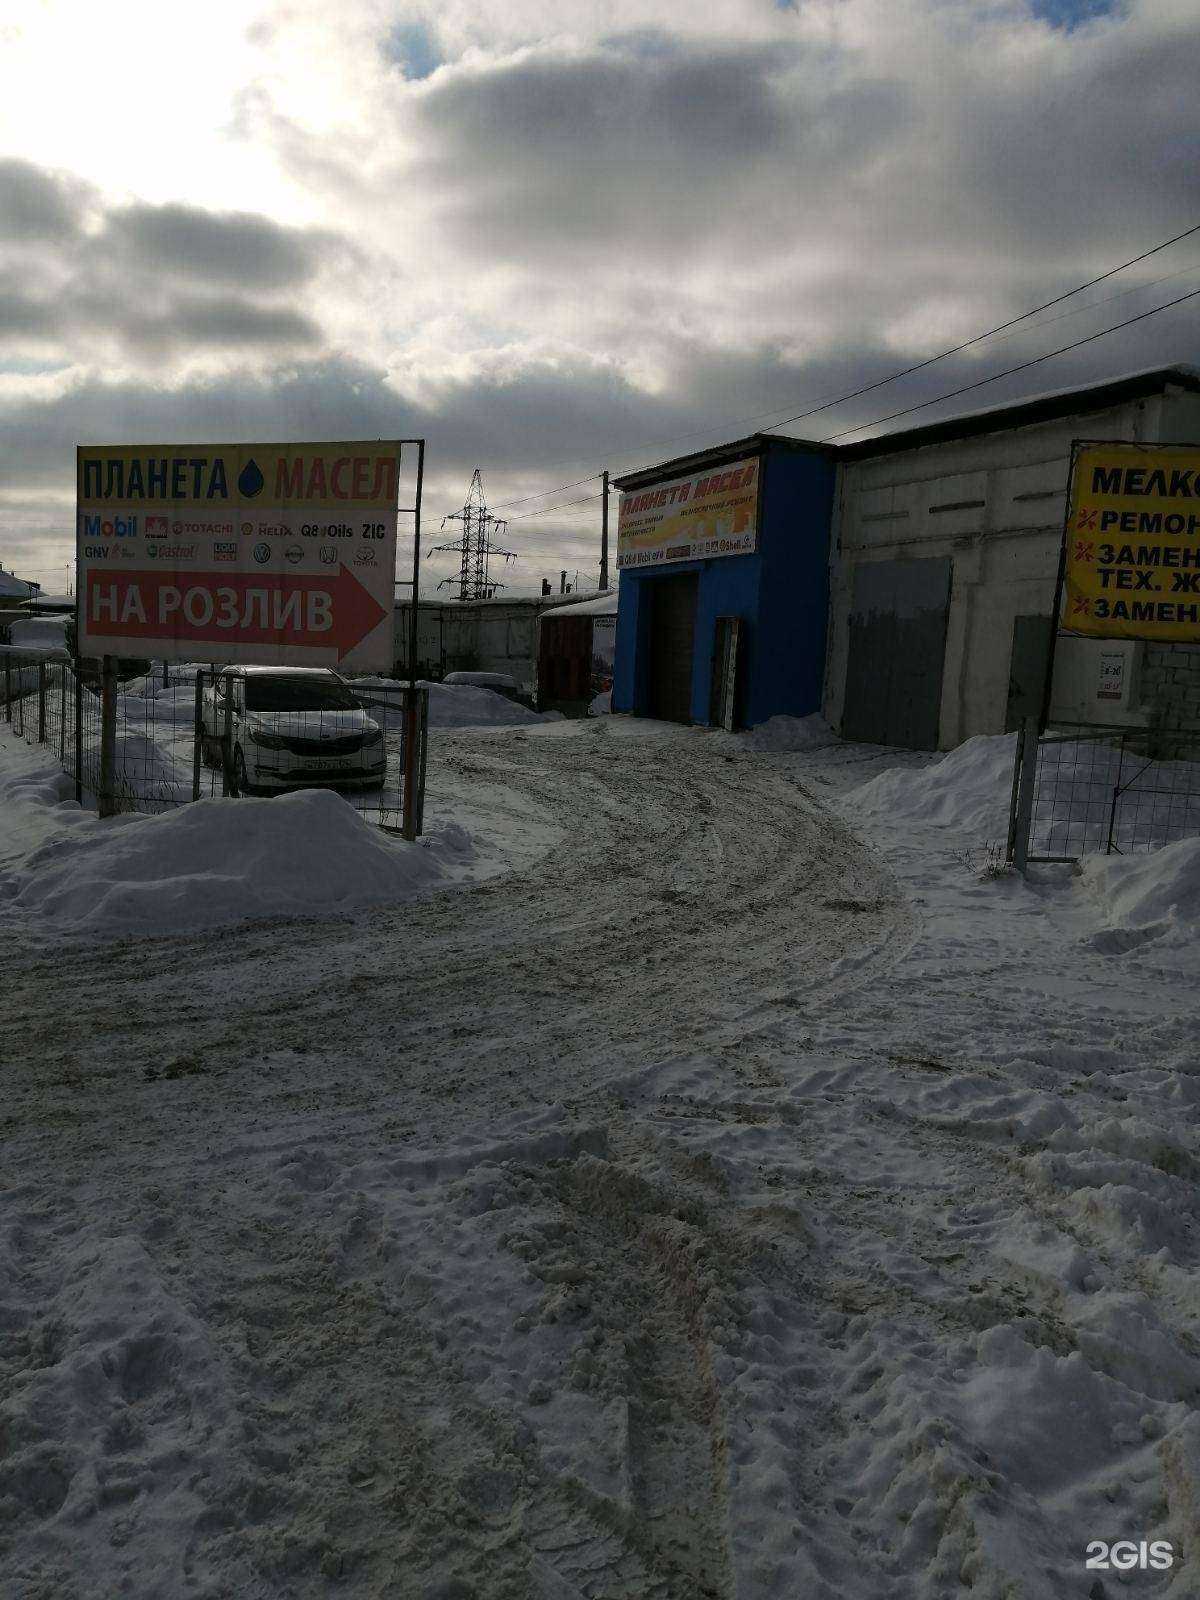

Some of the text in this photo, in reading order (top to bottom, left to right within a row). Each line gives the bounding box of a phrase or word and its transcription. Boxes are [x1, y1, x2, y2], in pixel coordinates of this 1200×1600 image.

[83, 456, 397, 500] ПЛАНЕТА МАСЕЛ
[1091, 467, 1200, 497] МЕЛК
[84, 515, 137, 538] Mobil
[185, 521, 233, 534] TOTACHI
[301, 523, 353, 538] Q8 Oils
[362, 523, 386, 539] ZIC
[159, 544, 194, 558] Castrol
[1097, 569, 1162, 591] ТЕХ.
[91, 583, 333, 633] НА РОЗЛИВ
[1094, 598, 1200, 622] ЗАМЕН
